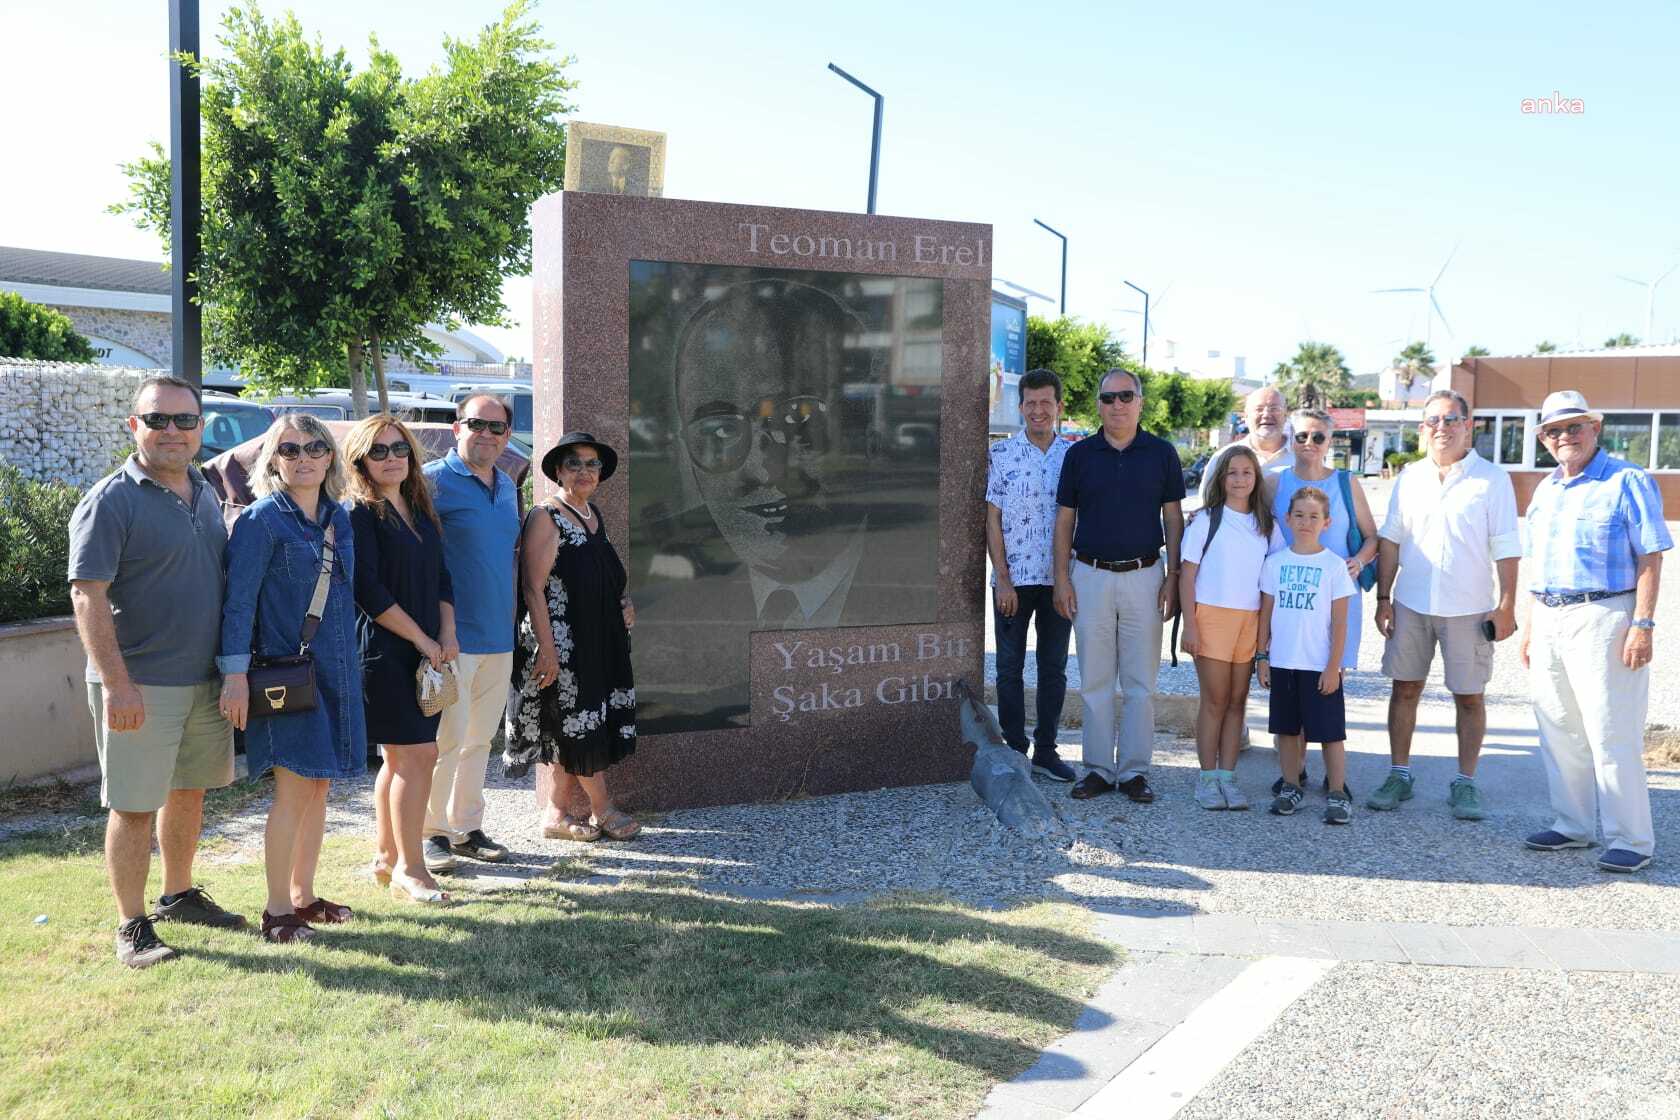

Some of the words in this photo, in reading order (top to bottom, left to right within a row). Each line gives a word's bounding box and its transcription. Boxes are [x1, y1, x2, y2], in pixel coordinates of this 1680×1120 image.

[738, 221, 898, 261] Teoman
[913, 234, 985, 267] Erel
[1279, 565, 1323, 588] NEVER
[1288, 583, 1308, 591] LOOK
[1279, 590, 1317, 611] BACK
[773, 641, 901, 674] Yaşam
[915, 633, 971, 660] Bir
[772, 682, 865, 722] Şaka
